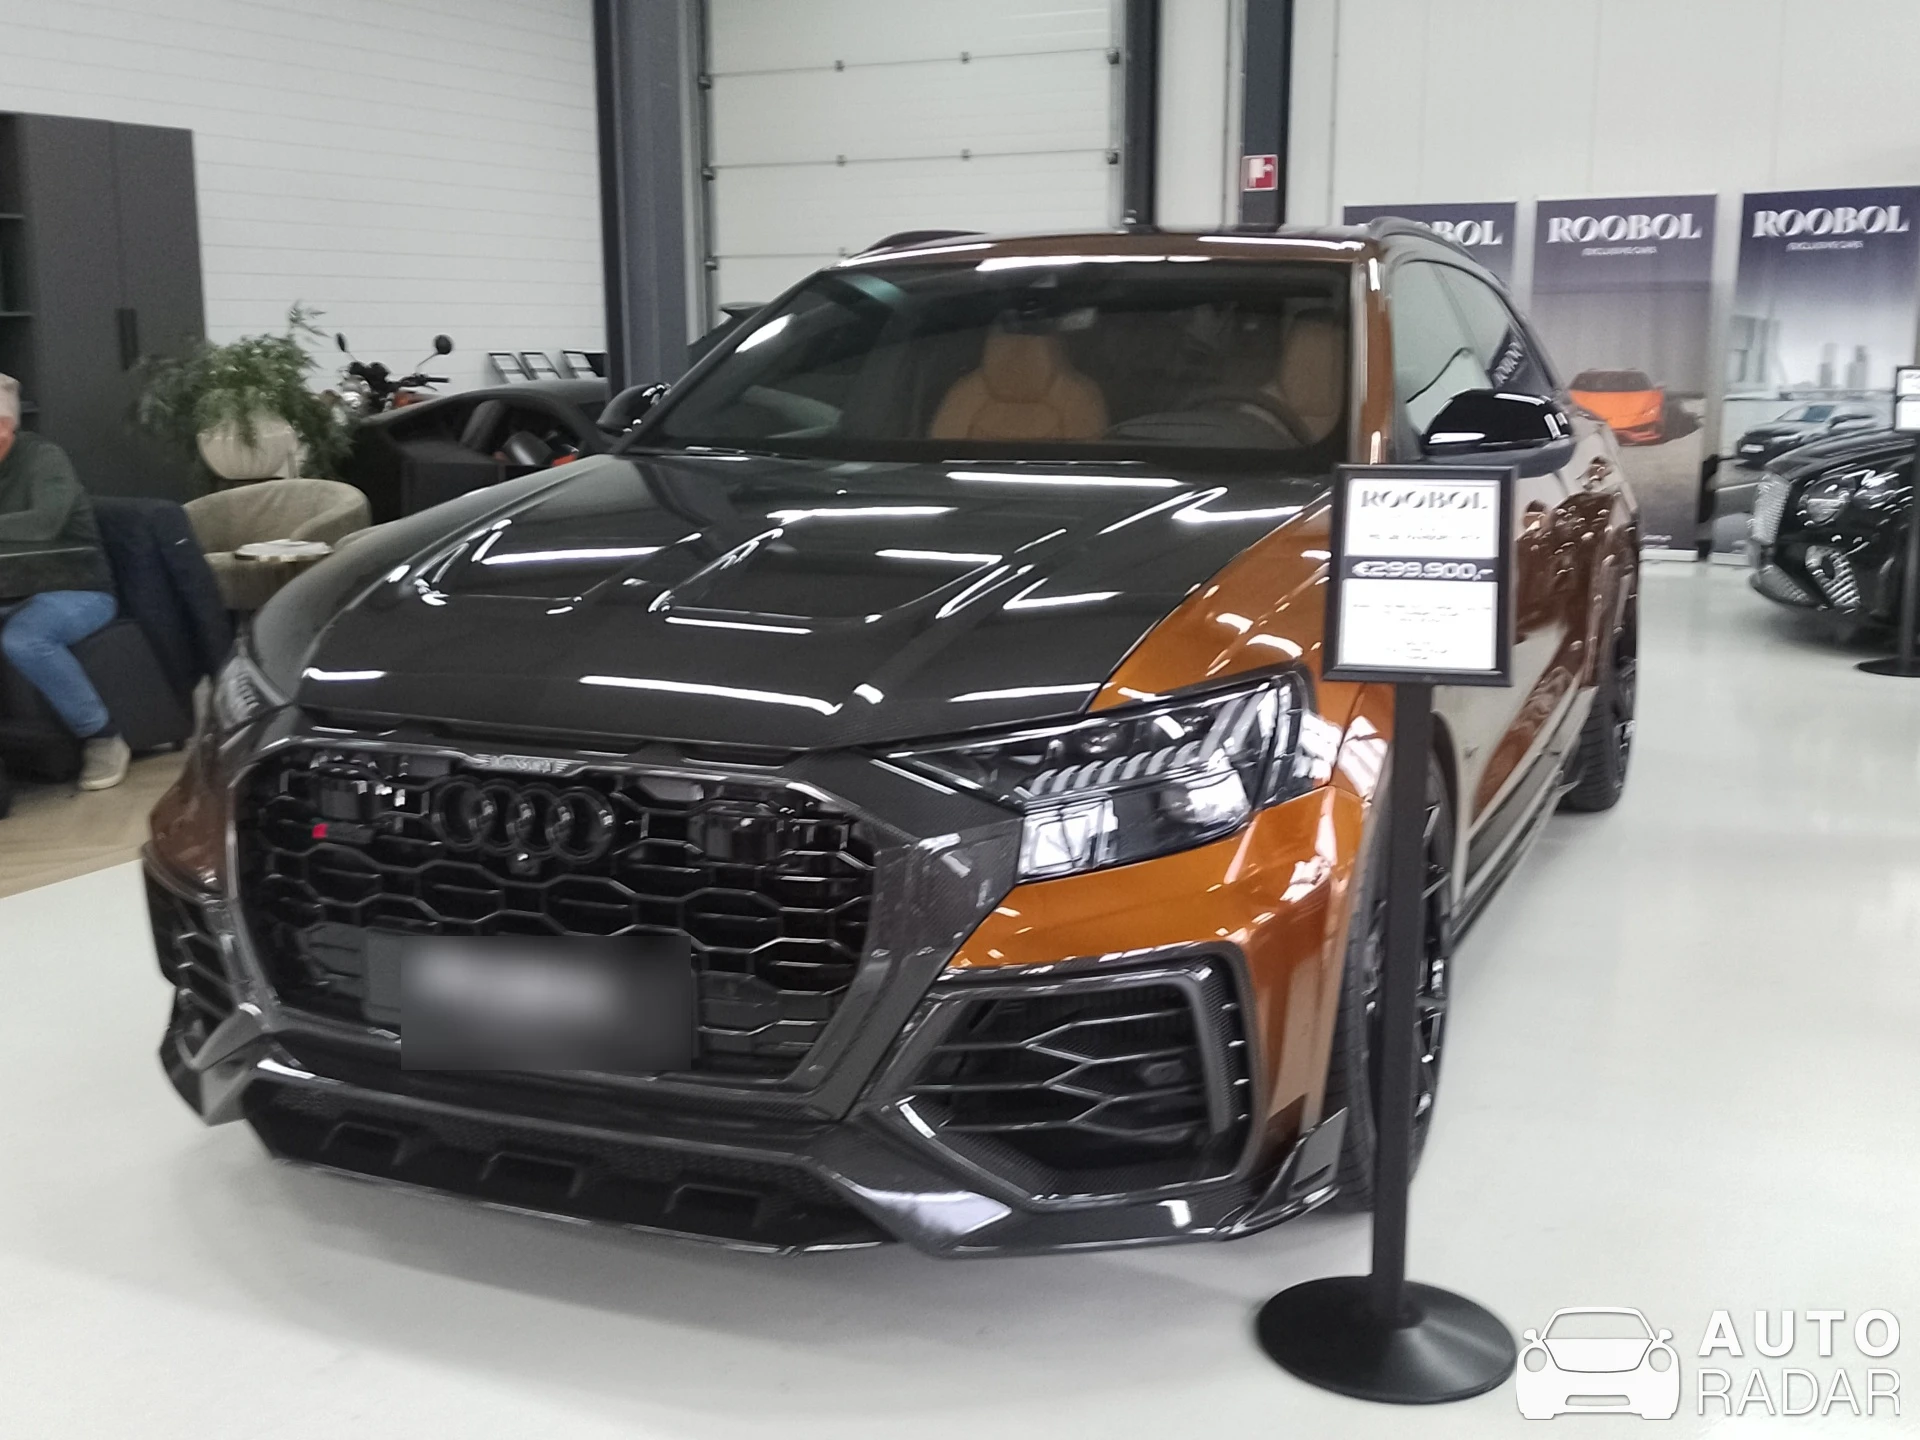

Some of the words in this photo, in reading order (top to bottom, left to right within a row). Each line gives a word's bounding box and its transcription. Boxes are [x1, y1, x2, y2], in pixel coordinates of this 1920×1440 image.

[1546, 213, 1702, 243] ROOBOL
[1753, 205, 1910, 238] ROOBOL
[1361, 490, 1489, 510] ROOBOL
